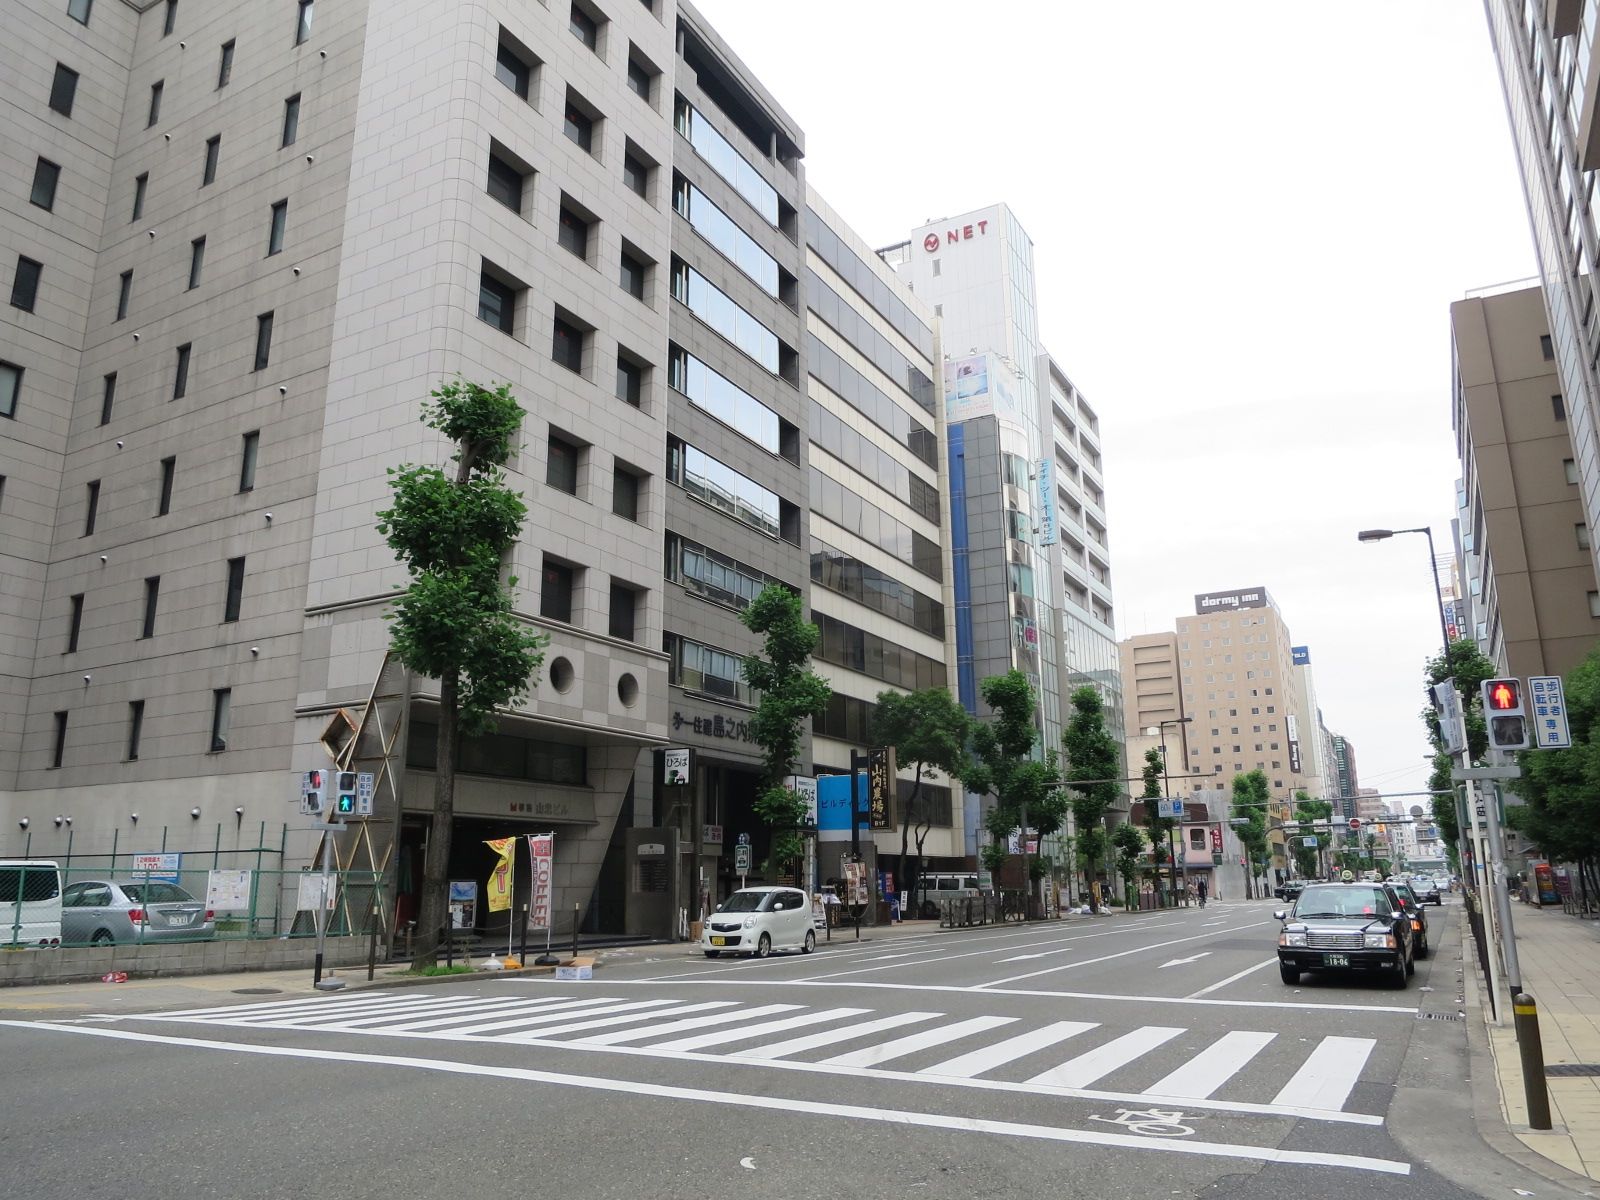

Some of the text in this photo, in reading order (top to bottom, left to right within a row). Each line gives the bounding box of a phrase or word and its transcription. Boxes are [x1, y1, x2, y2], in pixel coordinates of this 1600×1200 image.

[947, 220, 988, 245] NET
[1202, 593, 1259, 607] dormy inn
[1534, 682, 1548, 717] 自転車
[1546, 681, 1561, 717] 歩行者
[1545, 719, 1559, 743] 専用
[666, 757, 688, 768] ひろば
[535, 858, 550, 928] COFFEE
